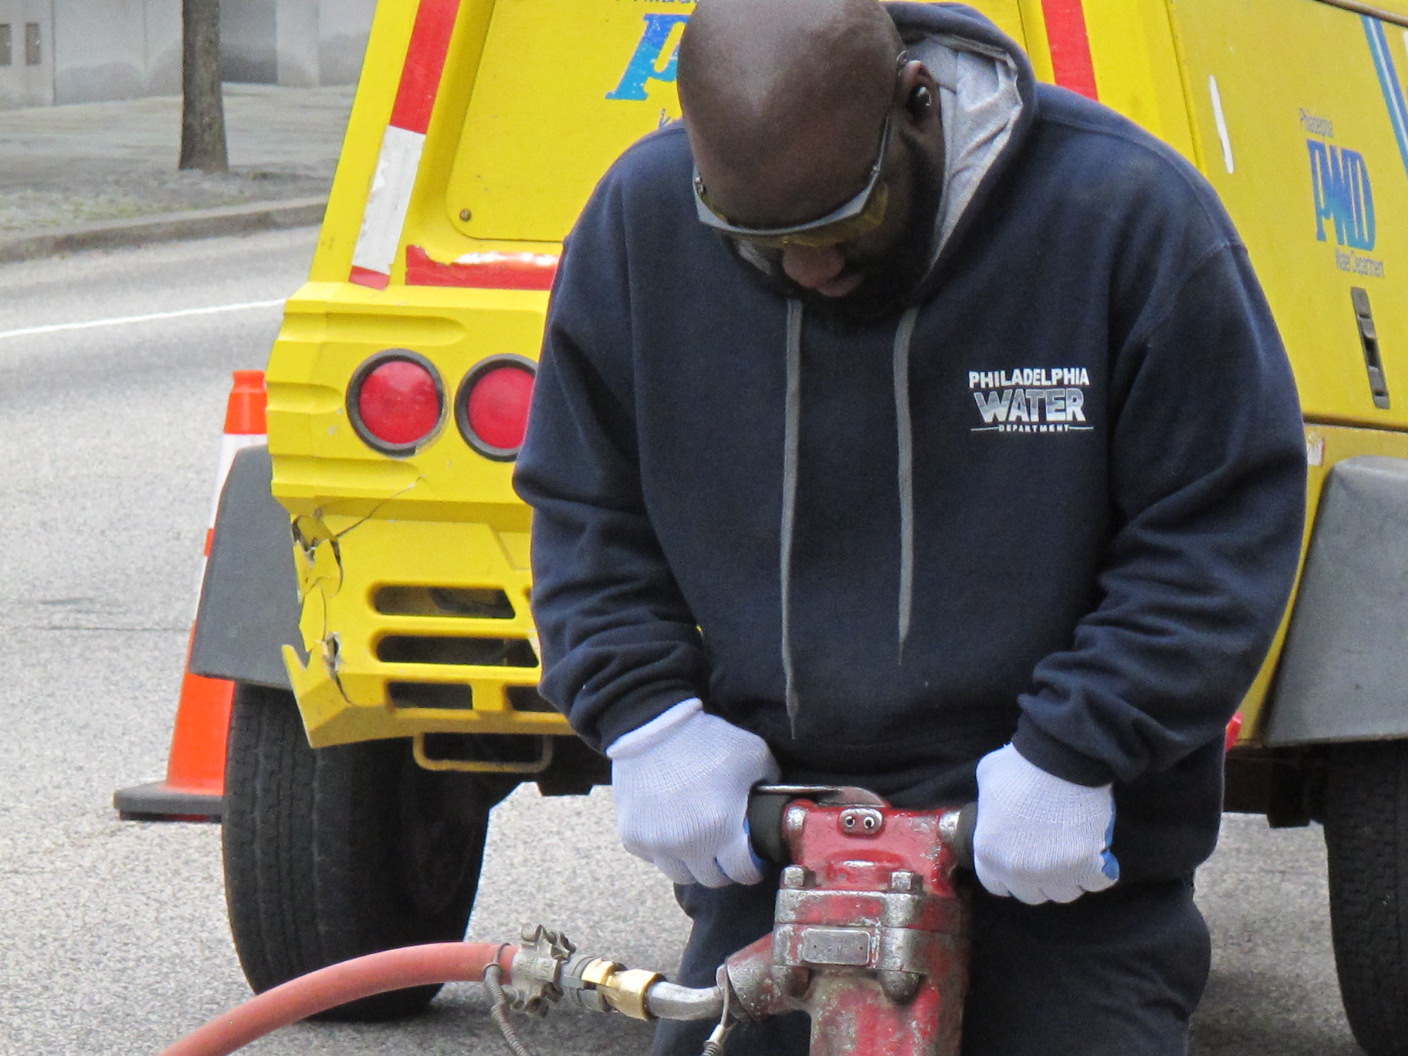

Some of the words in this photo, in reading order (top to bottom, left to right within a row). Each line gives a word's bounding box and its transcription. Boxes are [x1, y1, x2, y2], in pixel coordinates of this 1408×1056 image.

[1306, 138, 1376, 251] PWD
[968, 367, 1090, 388] PHILADELPHIA
[973, 388, 1087, 423] WATER
[998, 424, 1070, 433] DEPARTMENT
